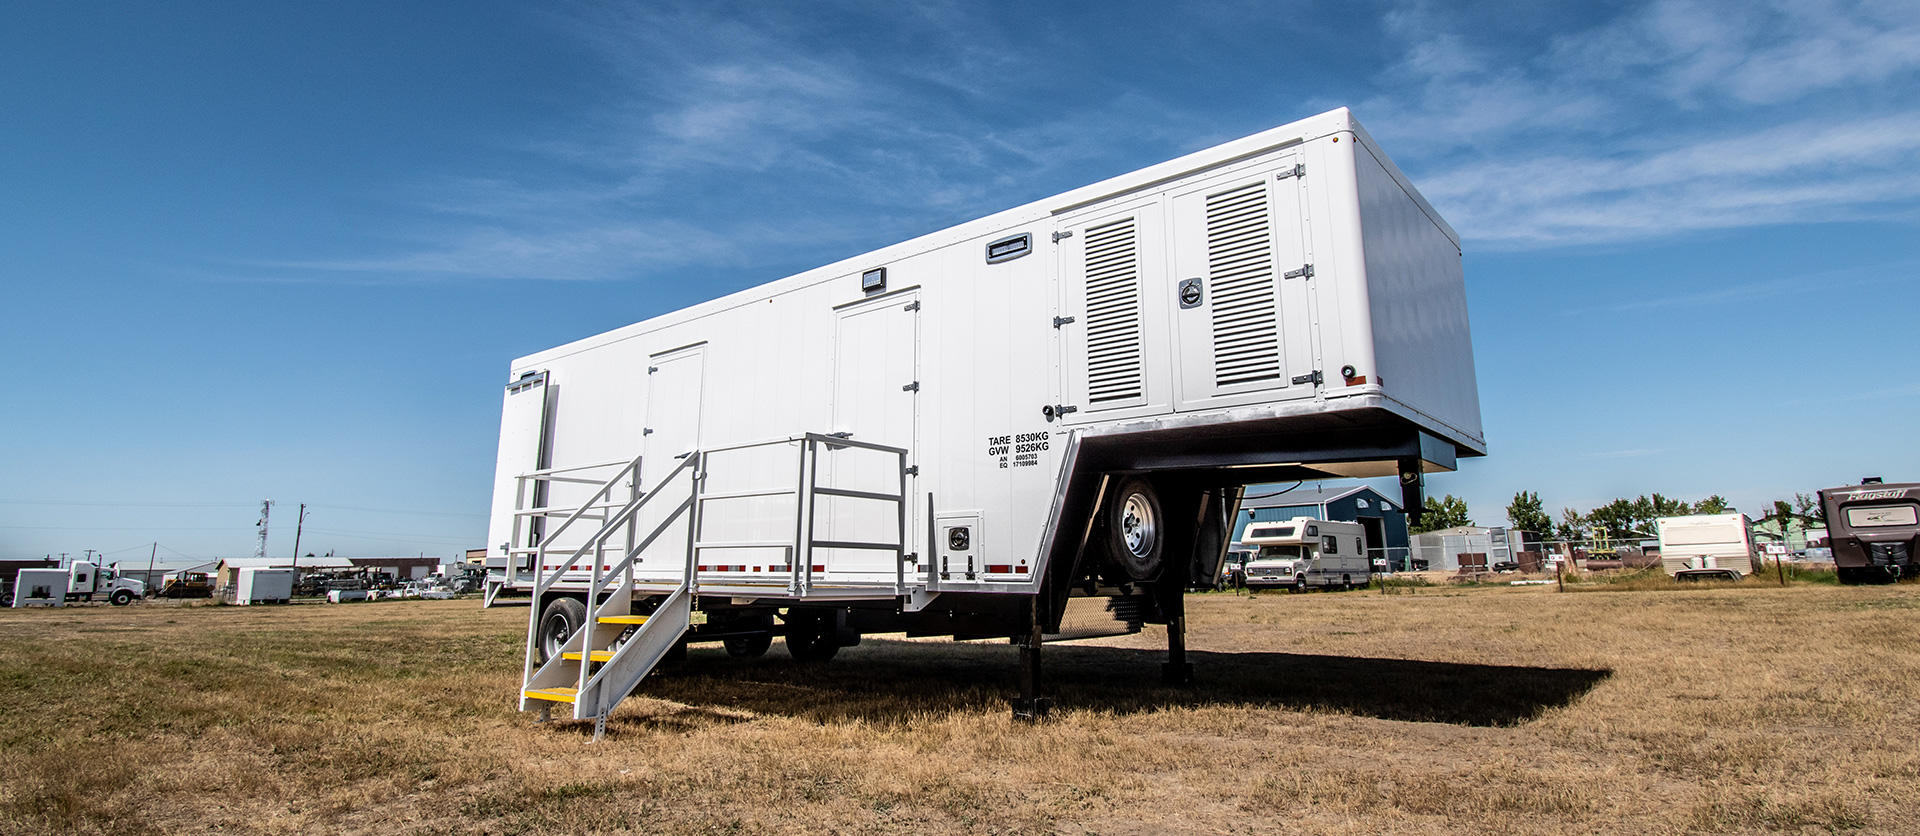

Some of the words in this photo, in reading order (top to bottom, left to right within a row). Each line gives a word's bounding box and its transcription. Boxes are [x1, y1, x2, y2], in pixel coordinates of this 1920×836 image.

[988, 435, 1011, 446] TARE
[1015, 431, 1049, 443] 8530KG
[988, 446, 1009, 456] GVW
[1015, 442, 1049, 453] 9526KG
[1847, 489, 1908, 501] Flagstaff
